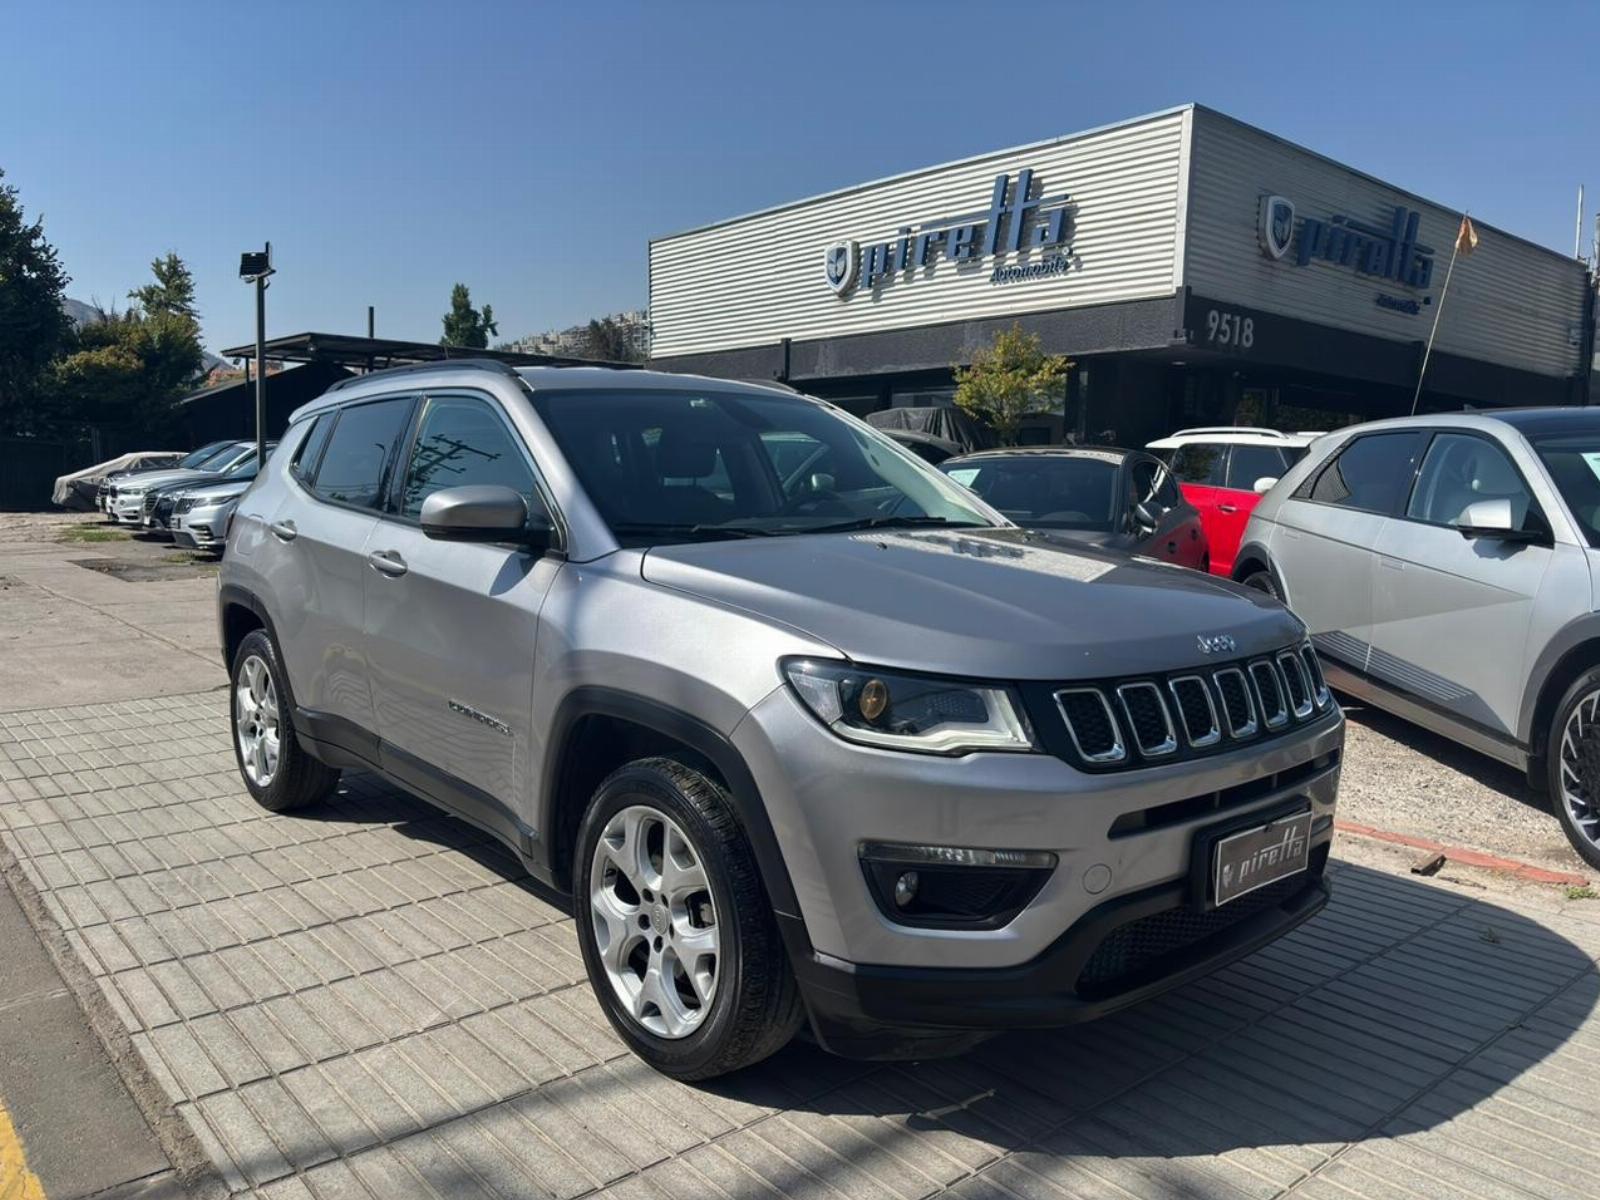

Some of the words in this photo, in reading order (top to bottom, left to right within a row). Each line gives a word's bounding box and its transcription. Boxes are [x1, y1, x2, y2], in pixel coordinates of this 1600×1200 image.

[861, 168, 1072, 289] piretta
[1207, 310, 1255, 348] 9518
[1239, 825, 1305, 884] piretta
